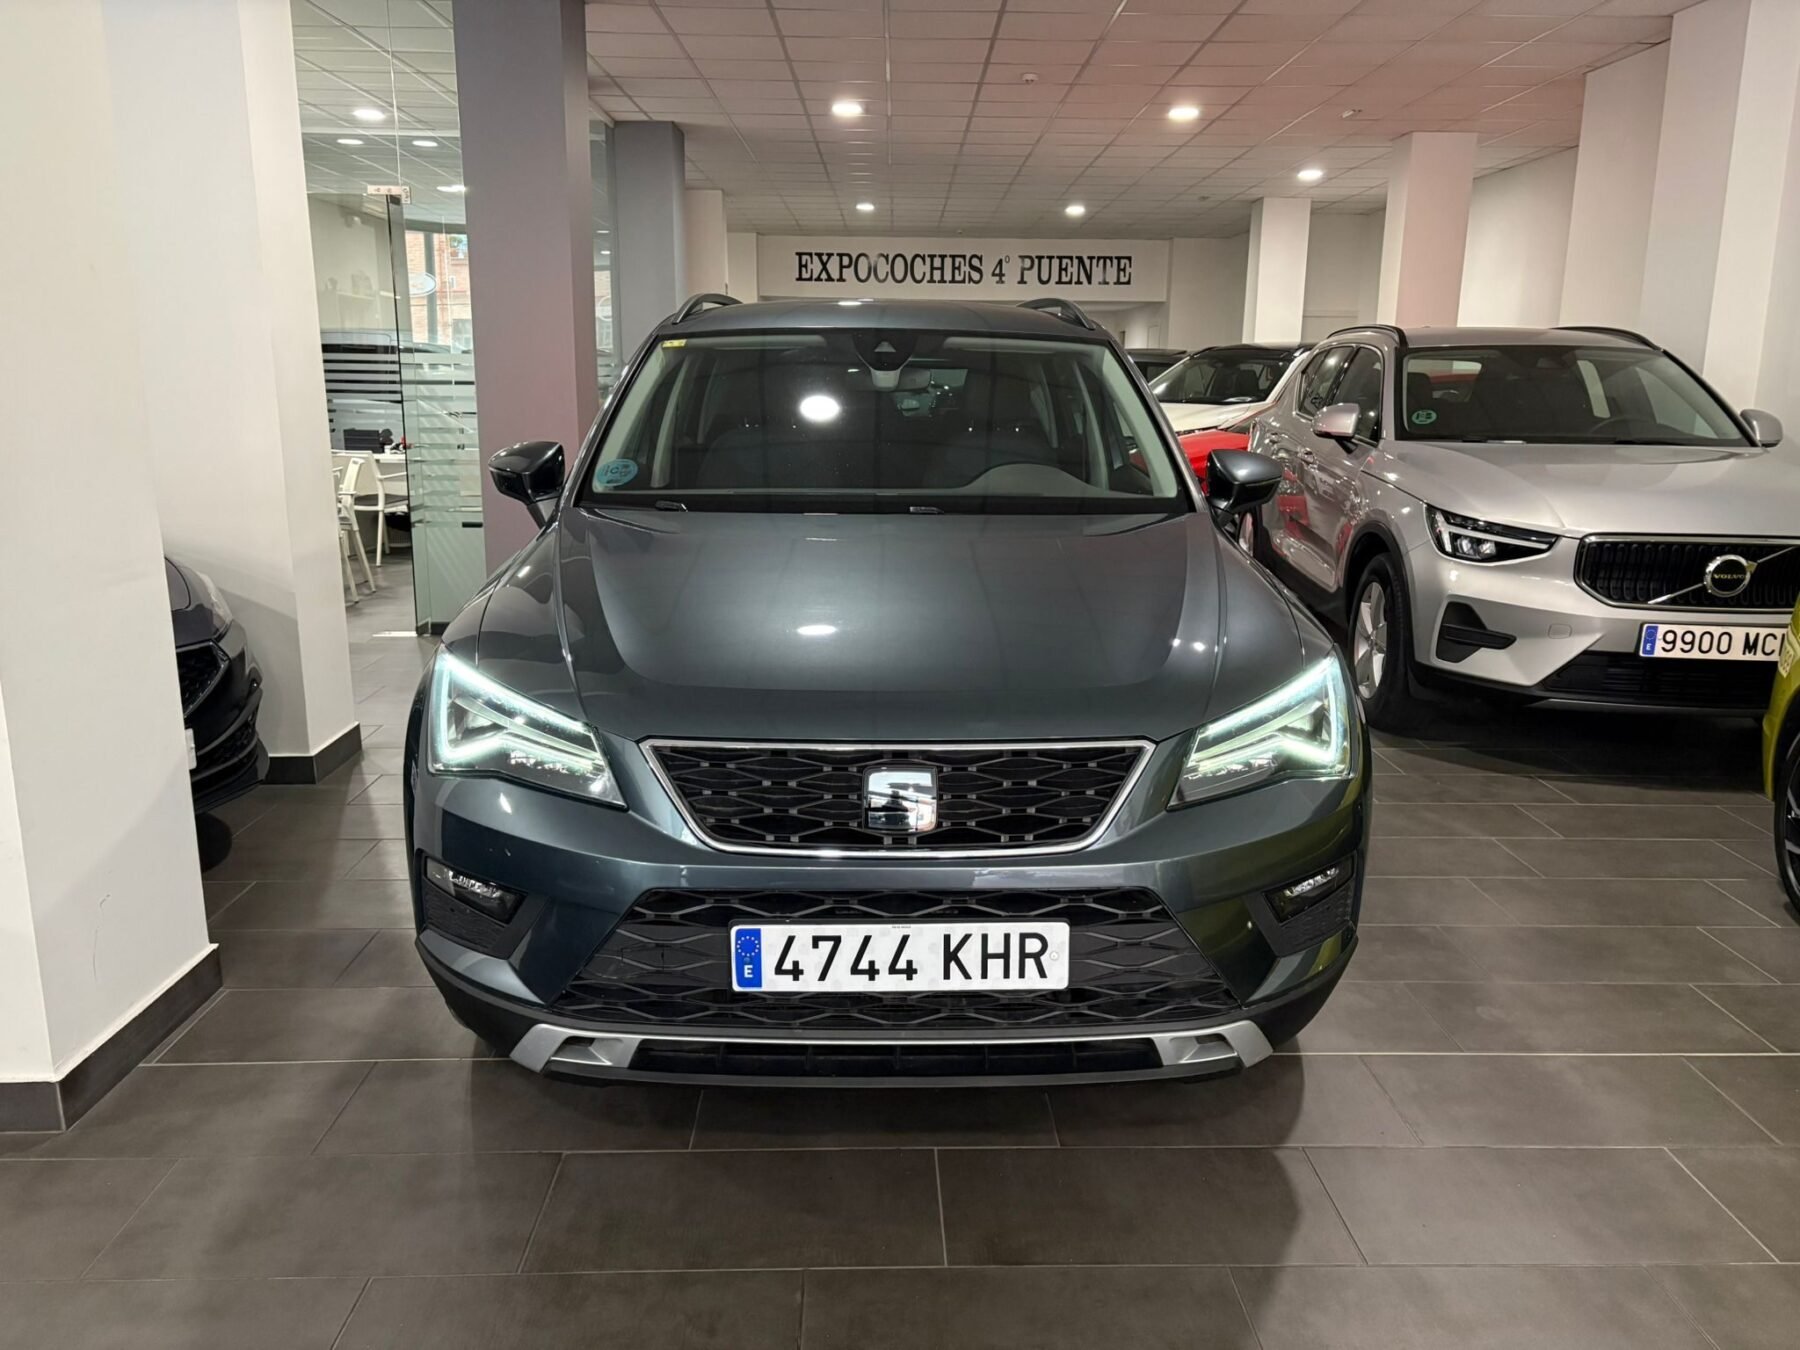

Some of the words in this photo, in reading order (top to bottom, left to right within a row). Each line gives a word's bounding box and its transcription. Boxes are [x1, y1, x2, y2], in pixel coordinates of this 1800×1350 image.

[795, 252, 983, 284] EXPOCOCHES
[1017, 255, 1133, 285] PUENTE
[1661, 630, 1733, 655] 9900
[744, 964, 754, 978] E
[774, 935, 918, 982] 4744
[943, 932, 1049, 981] KHR
